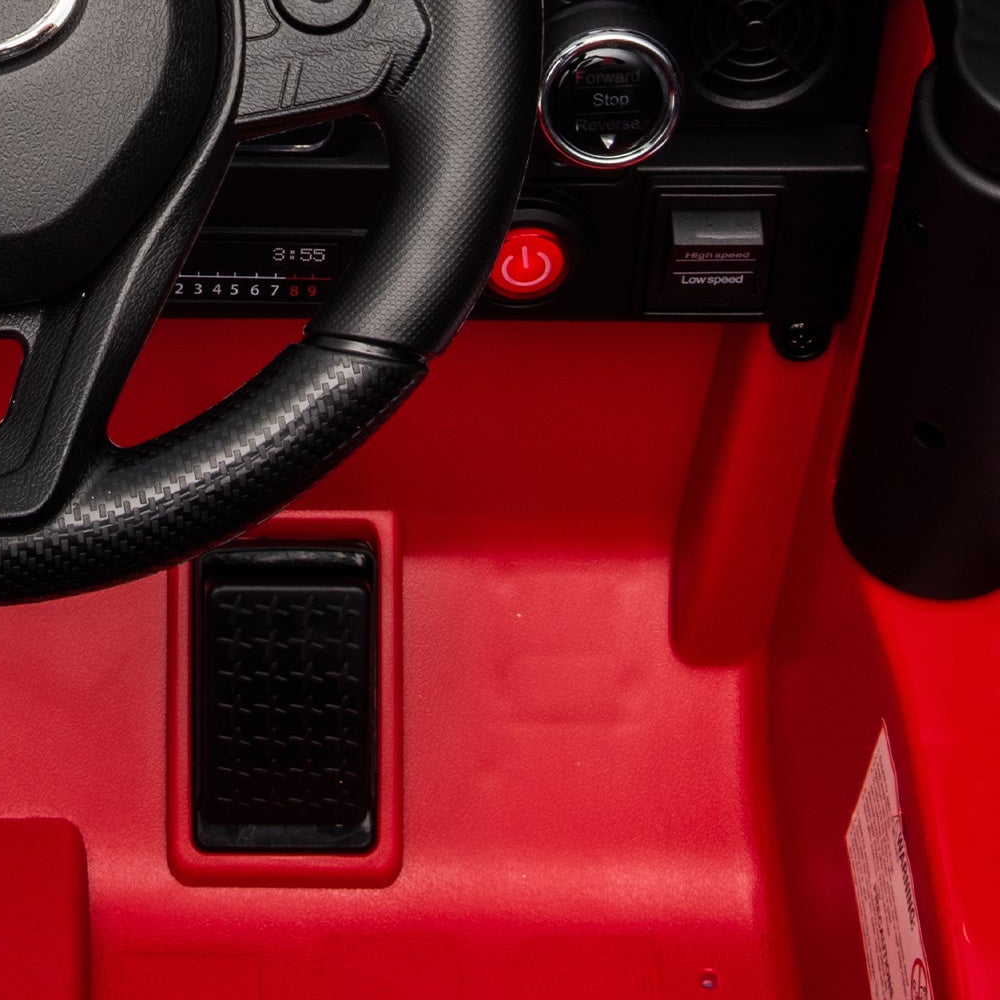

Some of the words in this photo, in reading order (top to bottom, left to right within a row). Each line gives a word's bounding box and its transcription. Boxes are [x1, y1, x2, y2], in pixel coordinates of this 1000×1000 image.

[575, 69, 640, 85] Forward
[592, 92, 629, 109] Stop
[576, 118, 640, 132] Reverse
[272, 247, 326, 262] 3:55
[685, 252, 713, 260] High
[715, 252, 750, 260] speed
[175, 284, 183, 294] 2
[194, 284, 202, 295] 3
[213, 284, 222, 294] 4
[230, 284, 239, 295] 5
[251, 284, 259, 296] 6
[270, 285, 279, 296] 7
[290, 285, 299, 297] 8
[307, 285, 317, 297] 9
